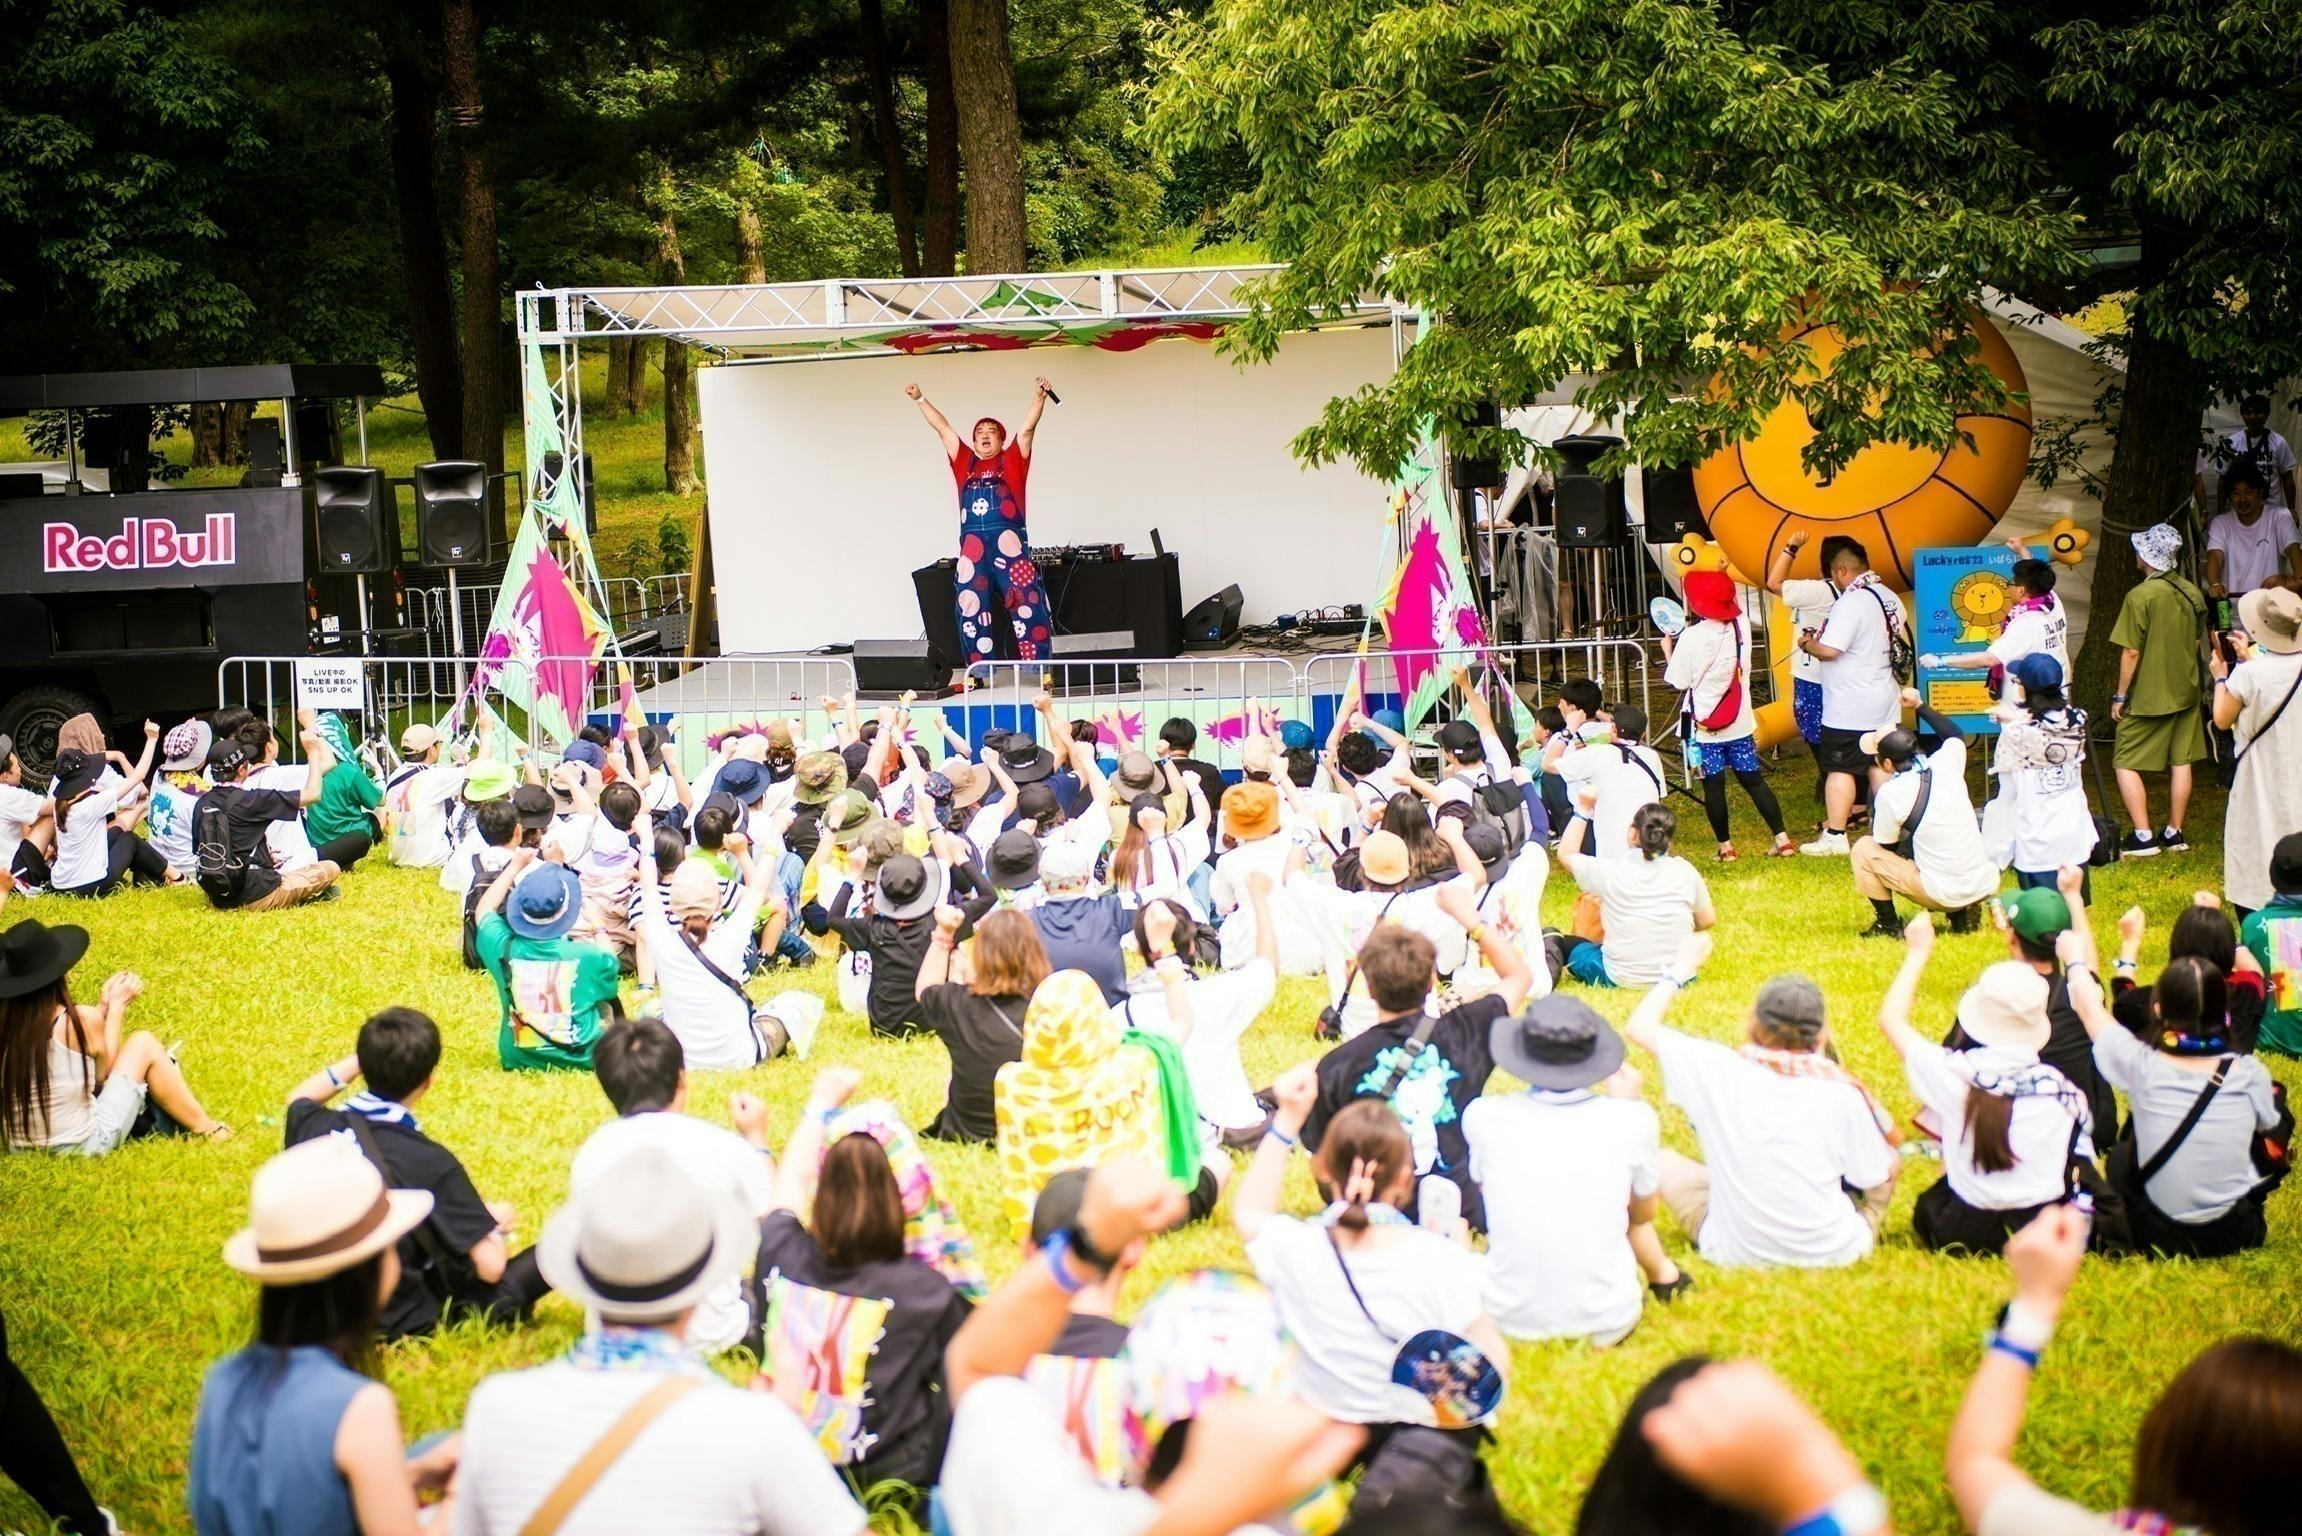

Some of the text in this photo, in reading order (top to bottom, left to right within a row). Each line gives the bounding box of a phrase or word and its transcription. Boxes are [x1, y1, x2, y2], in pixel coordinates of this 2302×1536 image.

[44, 514, 235, 571] Red Bull
[314, 669, 346, 677] LIVE中の
